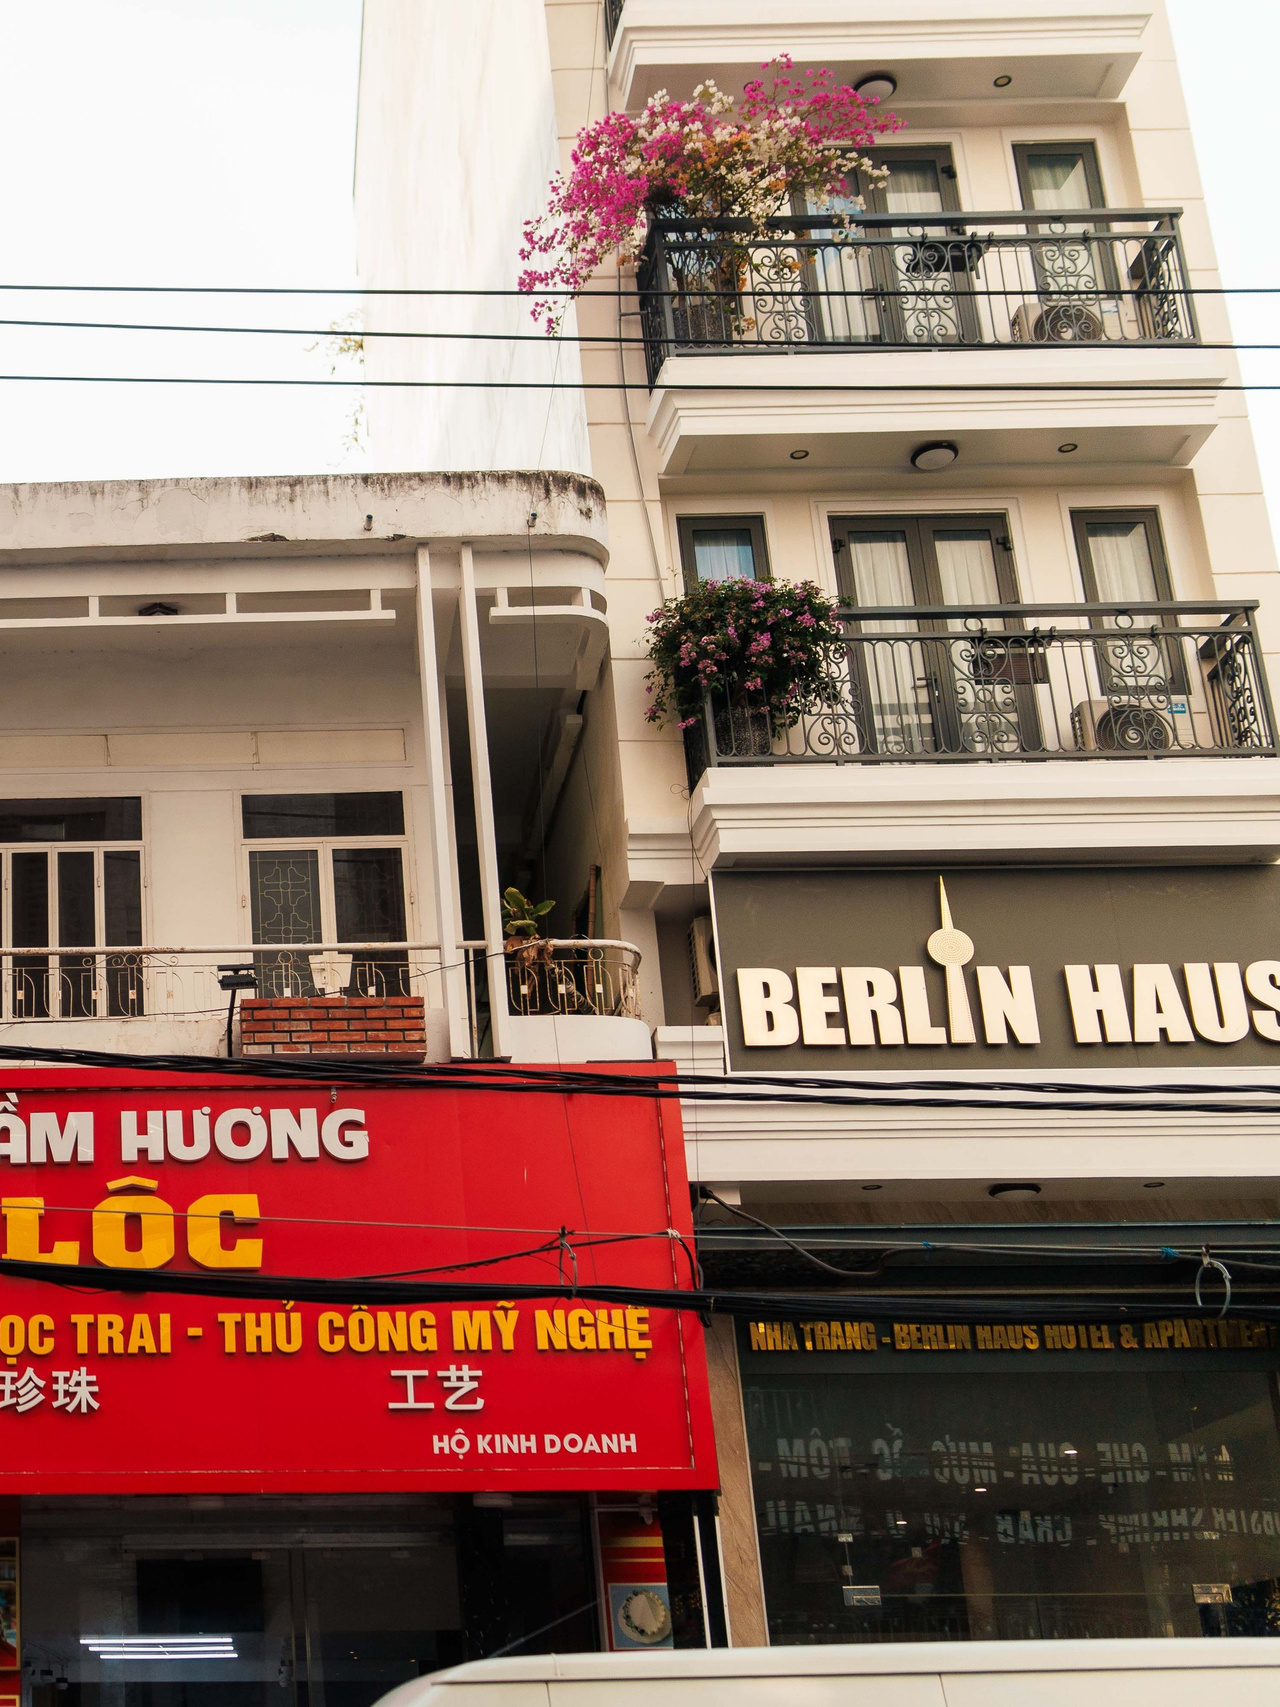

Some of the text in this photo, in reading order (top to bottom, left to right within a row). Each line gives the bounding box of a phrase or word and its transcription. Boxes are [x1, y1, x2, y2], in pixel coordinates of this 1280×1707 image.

[1063, 960, 1280, 1045] HAUS
[121, 1107, 370, 1162] HƯƠNG
[70, 1314, 170, 1354] TRAI
[187, 1327, 203, 1337] -
[218, 1301, 303, 1353] THỦ
[318, 1305, 438, 1353] CÔNG
[452, 1301, 520, 1351] MỸ
[535, 1305, 652, 1359] NGHỆ
[749, 1322, 799, 1351] NHA
[800, 1322, 878, 1351] TRANG
[893, 1323, 972, 1350] BERLIN
[976, 1324, 1040, 1350] HAUS
[1120, 1324, 1139, 1349] &
[388, 1365, 485, 1411] 工艺
[432, 1428, 637, 1460] HỘ KINH DOANH
